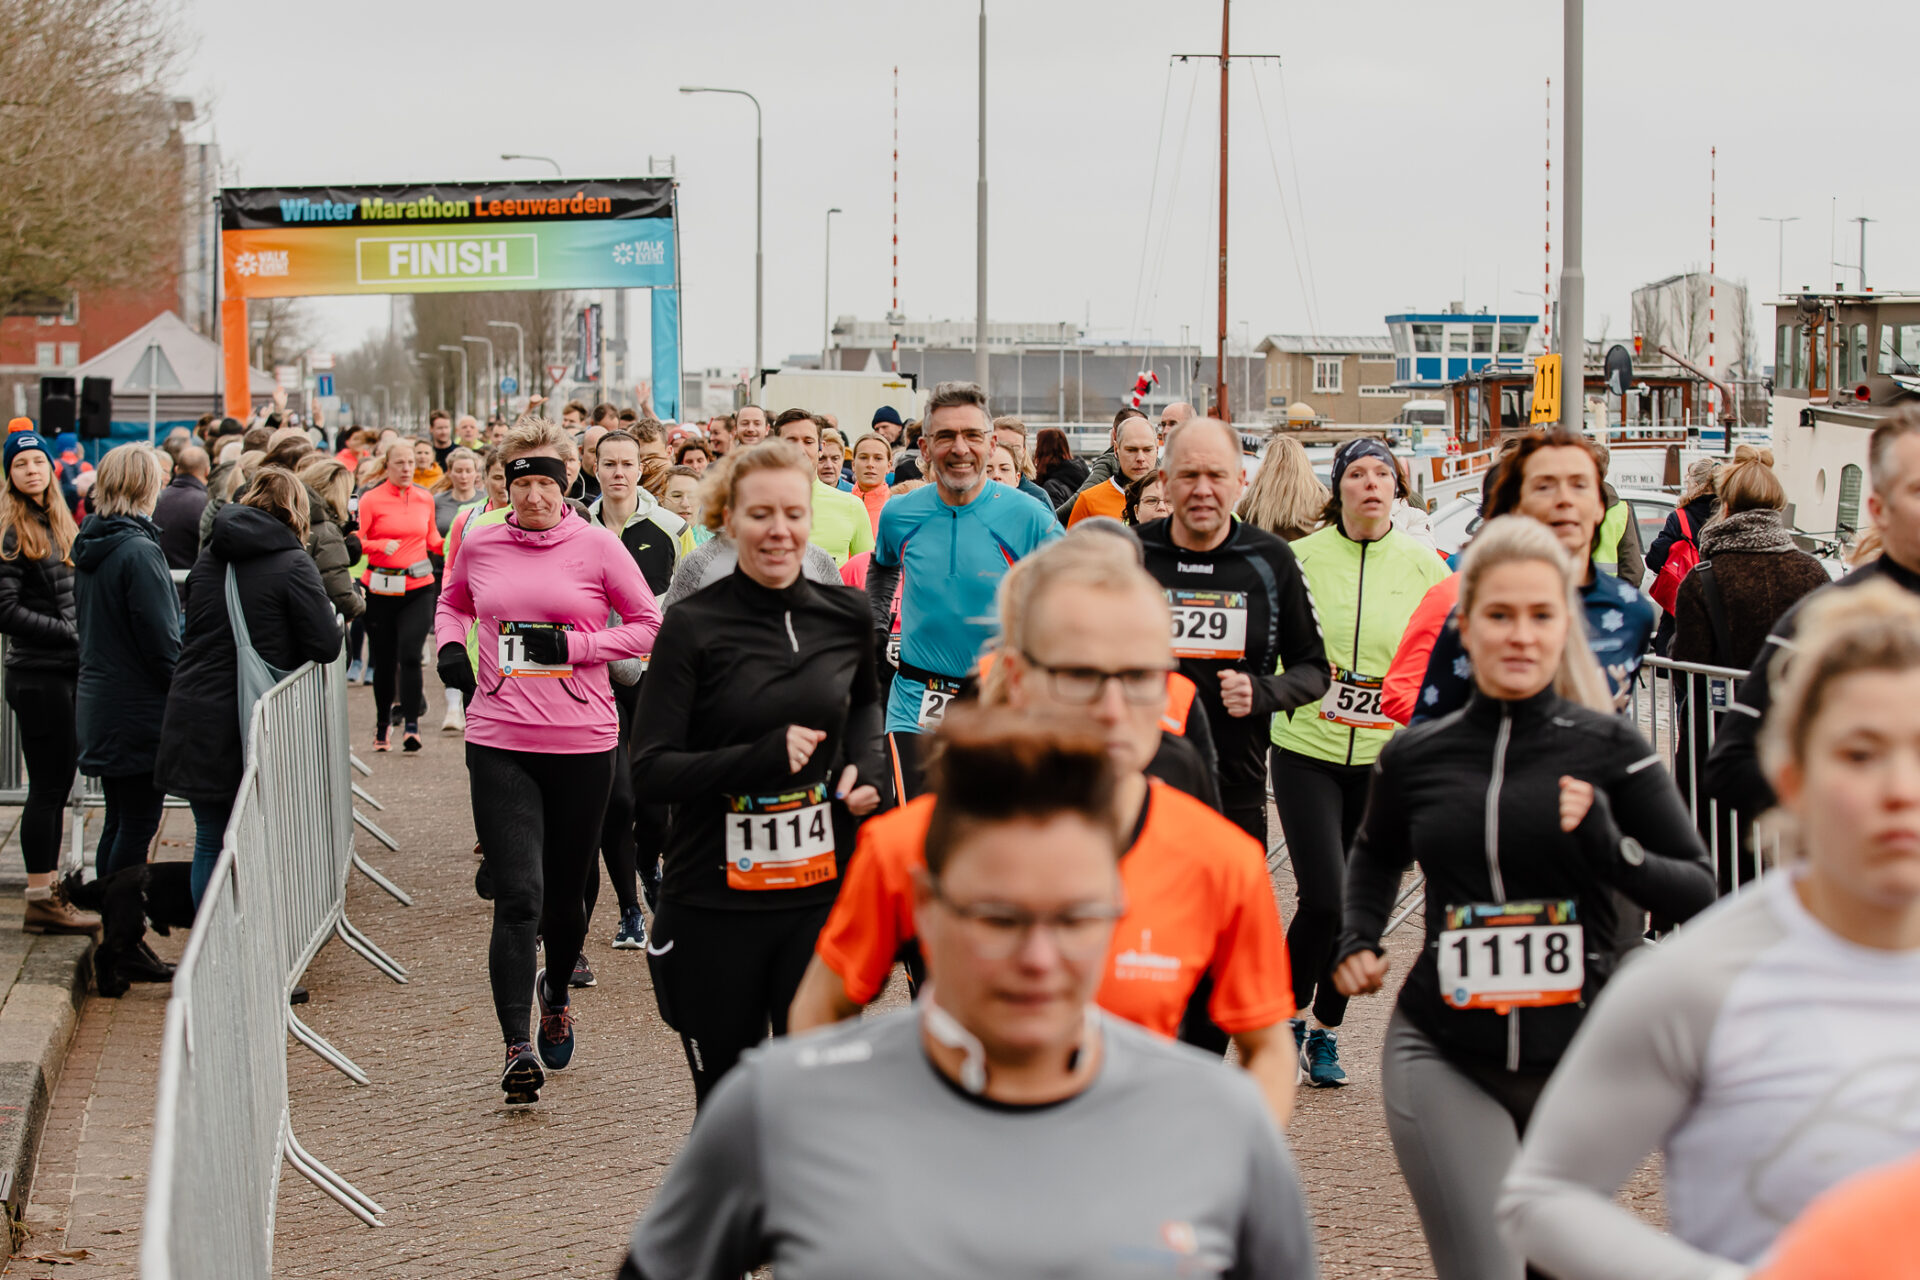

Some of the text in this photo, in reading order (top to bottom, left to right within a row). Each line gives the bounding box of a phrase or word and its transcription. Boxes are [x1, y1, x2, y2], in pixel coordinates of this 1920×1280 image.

[280, 191, 611, 222] Winter Marathon Leeuwarden
[258, 250, 288, 263] VALK
[389, 240, 508, 276] FINISH
[634, 240, 664, 251] VALK
[1337, 686, 1382, 715] 528
[736, 809, 826, 851] 1114
[804, 866, 829, 882] 1114
[1451, 932, 1570, 978] 1118
